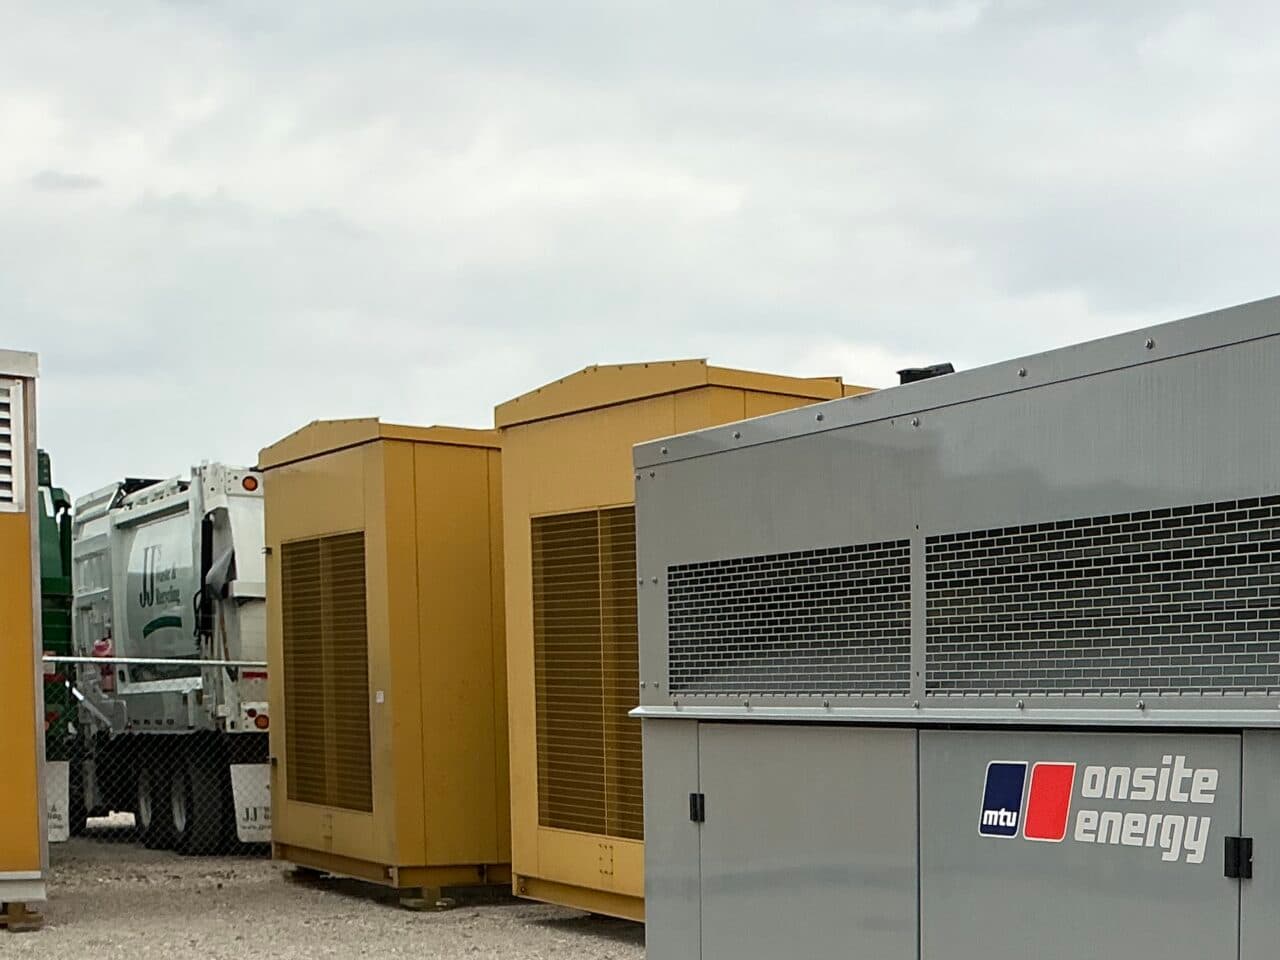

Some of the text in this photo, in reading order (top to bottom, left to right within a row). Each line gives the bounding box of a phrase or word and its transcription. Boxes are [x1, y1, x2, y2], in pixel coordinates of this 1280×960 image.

[1081, 754, 1219, 804] onsite
[982, 807, 1017, 827] mtu
[1074, 809, 1211, 864] energy
